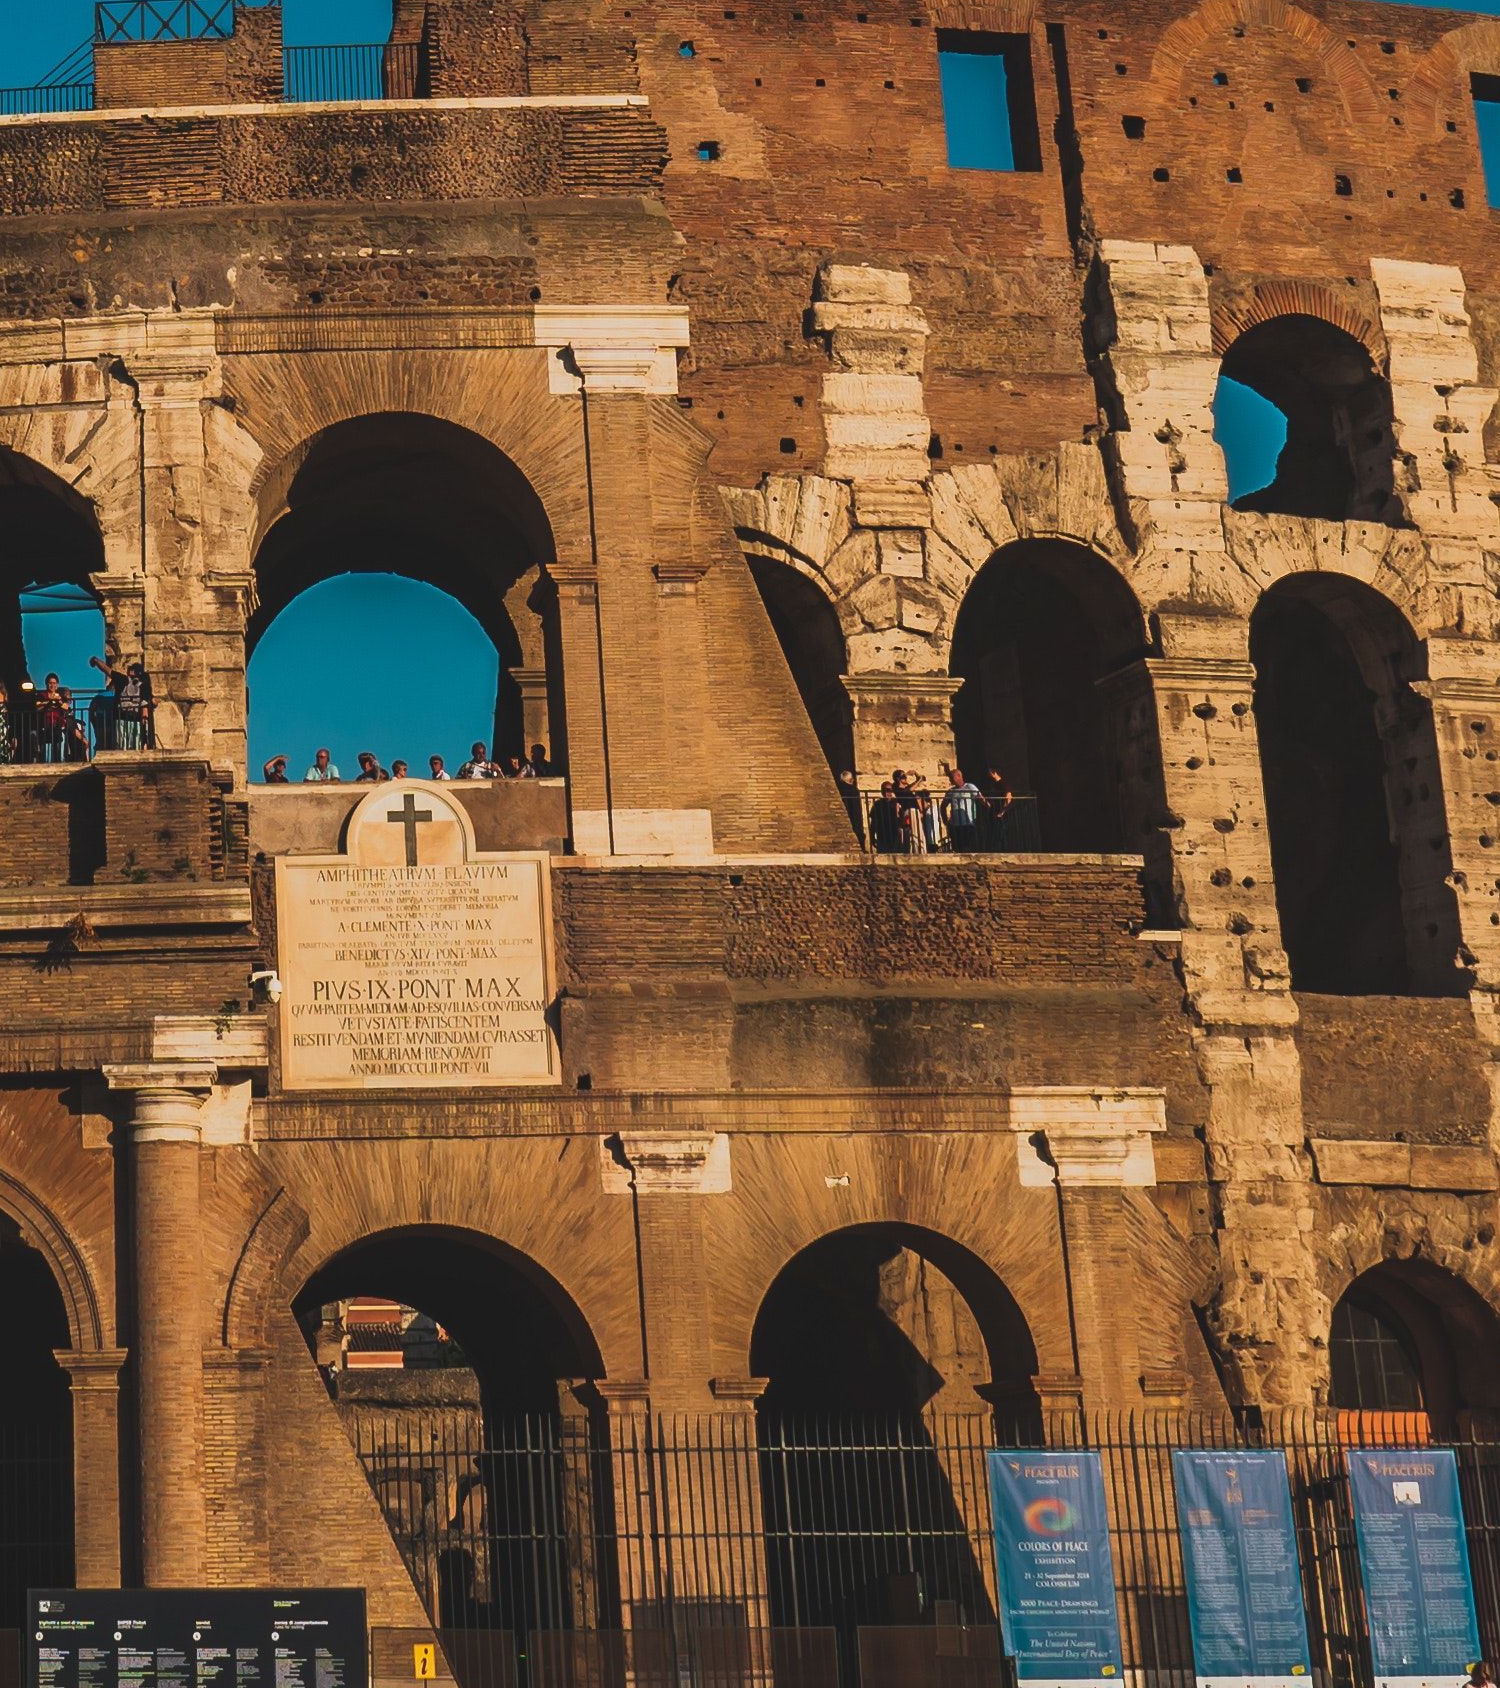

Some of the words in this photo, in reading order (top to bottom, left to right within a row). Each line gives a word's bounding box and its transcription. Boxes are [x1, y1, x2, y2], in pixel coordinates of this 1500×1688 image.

[317, 868, 436, 882] AMPHITHEATRVM
[444, 866, 508, 880] FLAVIVM
[351, 921, 411, 933] CLEMENTE
[430, 920, 460, 931] PONT
[465, 919, 492, 930] MAX
[335, 949, 405, 961] BENEDICTVS
[436, 948, 465, 959] PONT
[470, 947, 498, 959] MAX
[313, 980, 361, 1000] PIVS
[368, 980, 391, 1000] IX
[398, 978, 456, 999] PONT
[465, 977, 521, 998] MAX
[324, 1003, 364, 1014] PARTEM
[366, 1002, 407, 1014] MEDIAM
[411, 1002, 425, 1012] AD
[481, 1000, 545, 1012] CONVERSAM
[339, 1017, 412, 1029] VETVSTATE
[415, 1015, 500, 1028] FATISCENTEM
[387, 1032, 400, 1044] ET
[406, 1031, 479, 1044] MVNIENDAM
[483, 1029, 545, 1043] CVRASSET
[352, 1047, 421, 1060] MEMORIAM
[425, 1046, 493, 1060] RENOVAVIT
[349, 1063, 381, 1074] ANNO
[440, 1062, 469, 1073] PONT
[1018, 1541, 1051, 1552] COLORS
[1052, 1541, 1063, 1551] OF
[1065, 1541, 1088, 1551] PEACE
[1034, 1557, 1076, 1565] EXHIBITION
[1035, 1580, 1080, 1588] COLOSSEUM
[1070, 1640, 1096, 1648] Nations
